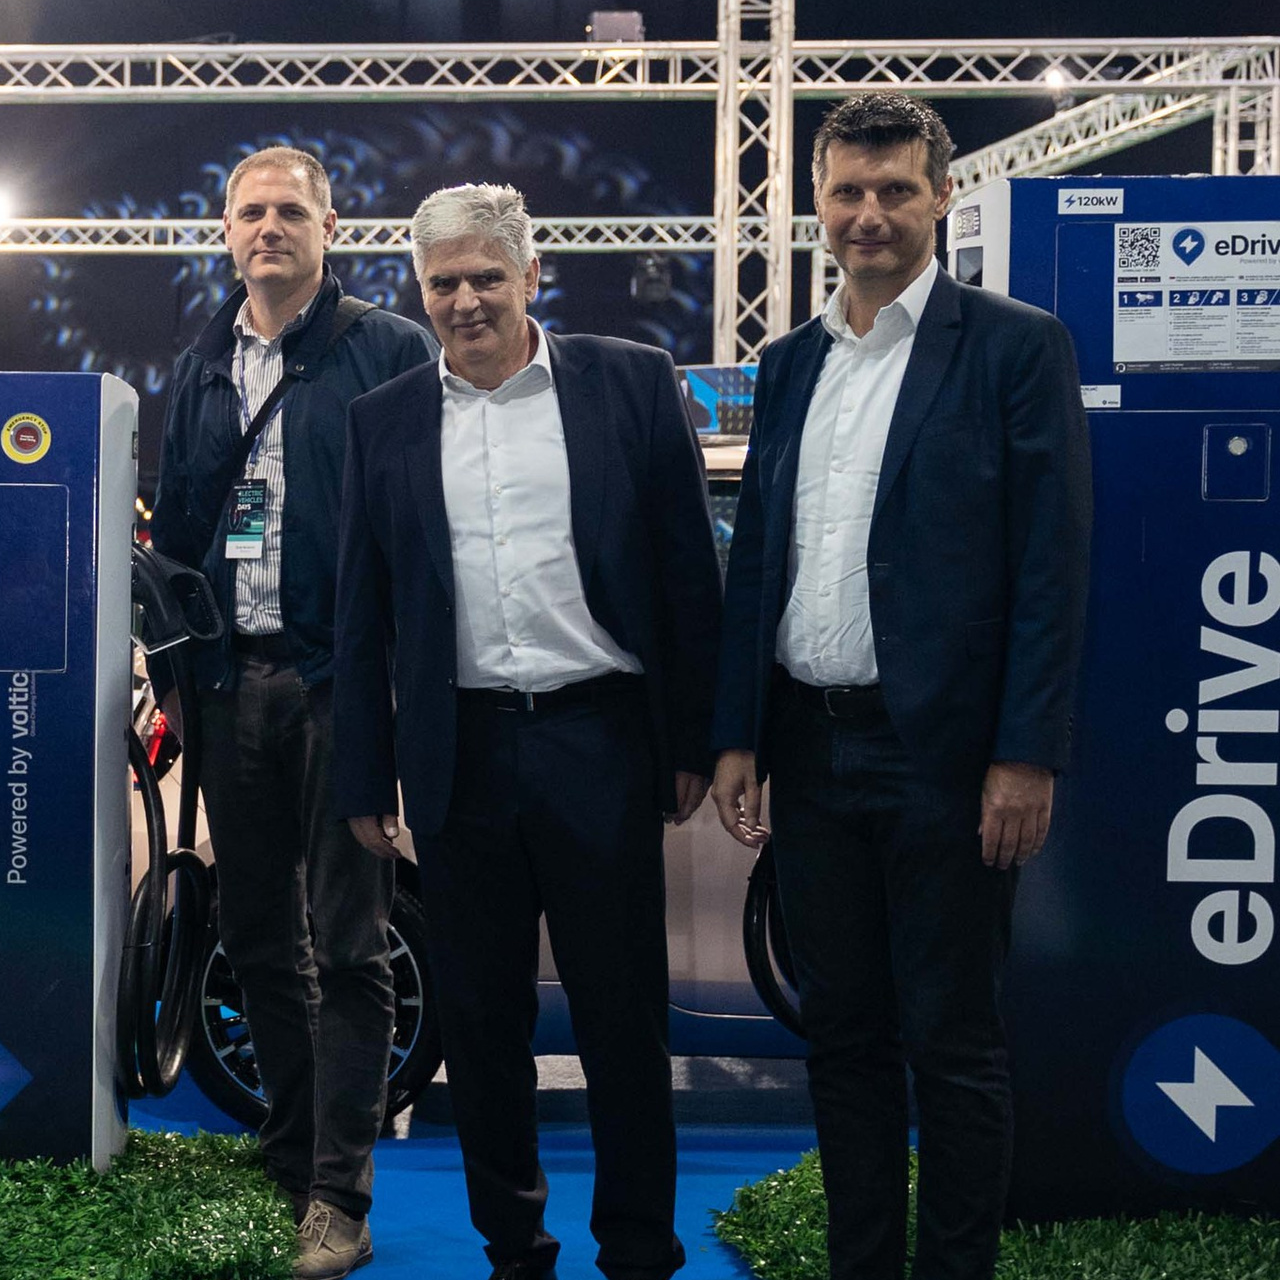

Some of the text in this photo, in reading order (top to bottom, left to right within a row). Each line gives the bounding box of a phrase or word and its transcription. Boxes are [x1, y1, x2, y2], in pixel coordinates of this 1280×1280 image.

[1078, 196, 1118, 206] 120kW
[1123, 294, 1128, 304] 1
[1173, 293, 1181, 303] 2
[1241, 293, 1249, 302] 3
[1165, 551, 1280, 965] eDrive
[7, 671, 32, 884] Powered by voltic
